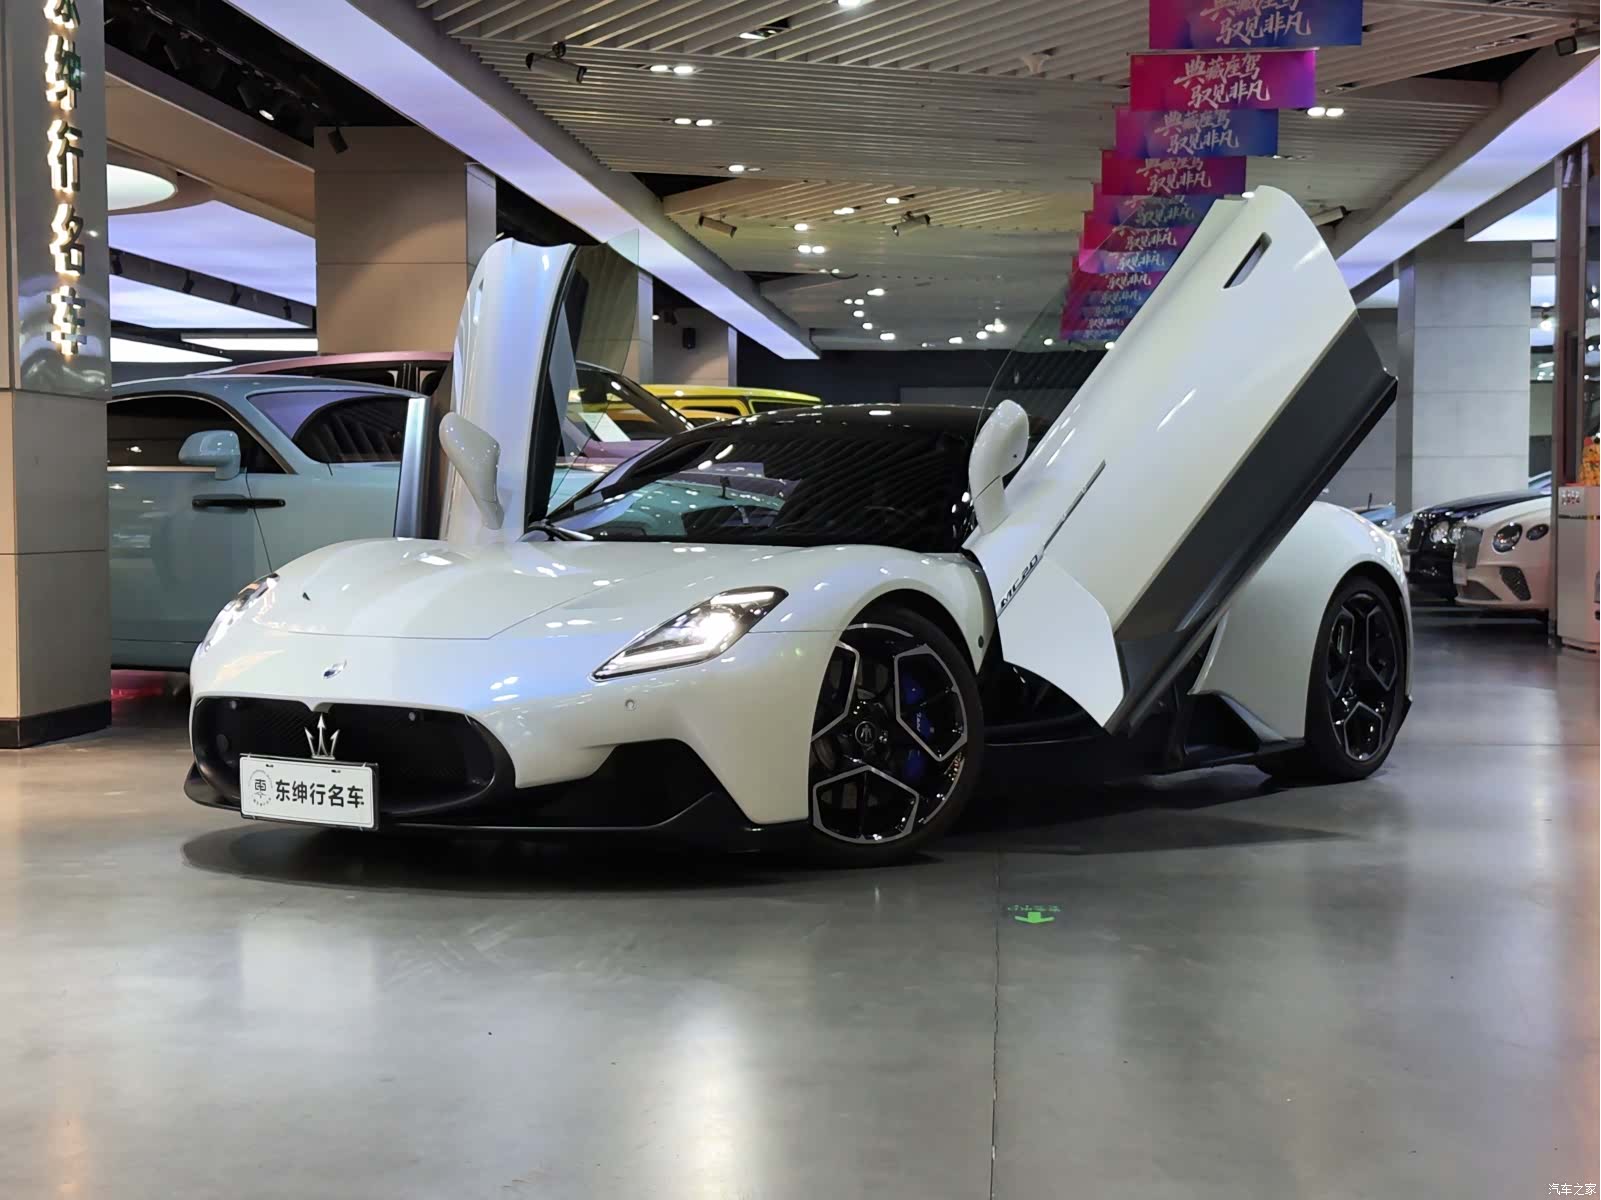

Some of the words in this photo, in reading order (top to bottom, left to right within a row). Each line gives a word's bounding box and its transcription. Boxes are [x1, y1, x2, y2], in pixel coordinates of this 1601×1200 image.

[1216, 12, 1311, 45] 驭见非凡
[1173, 53, 1262, 89] 典藏座驾
[1187, 80, 1271, 109] 驭见非凡
[1154, 109, 1230, 136] 典藏座驾
[1167, 130, 1239, 155] 驭见非凡
[1001, 555, 1038, 607] MC20
[275, 779, 365, 808] 东绅行名车
